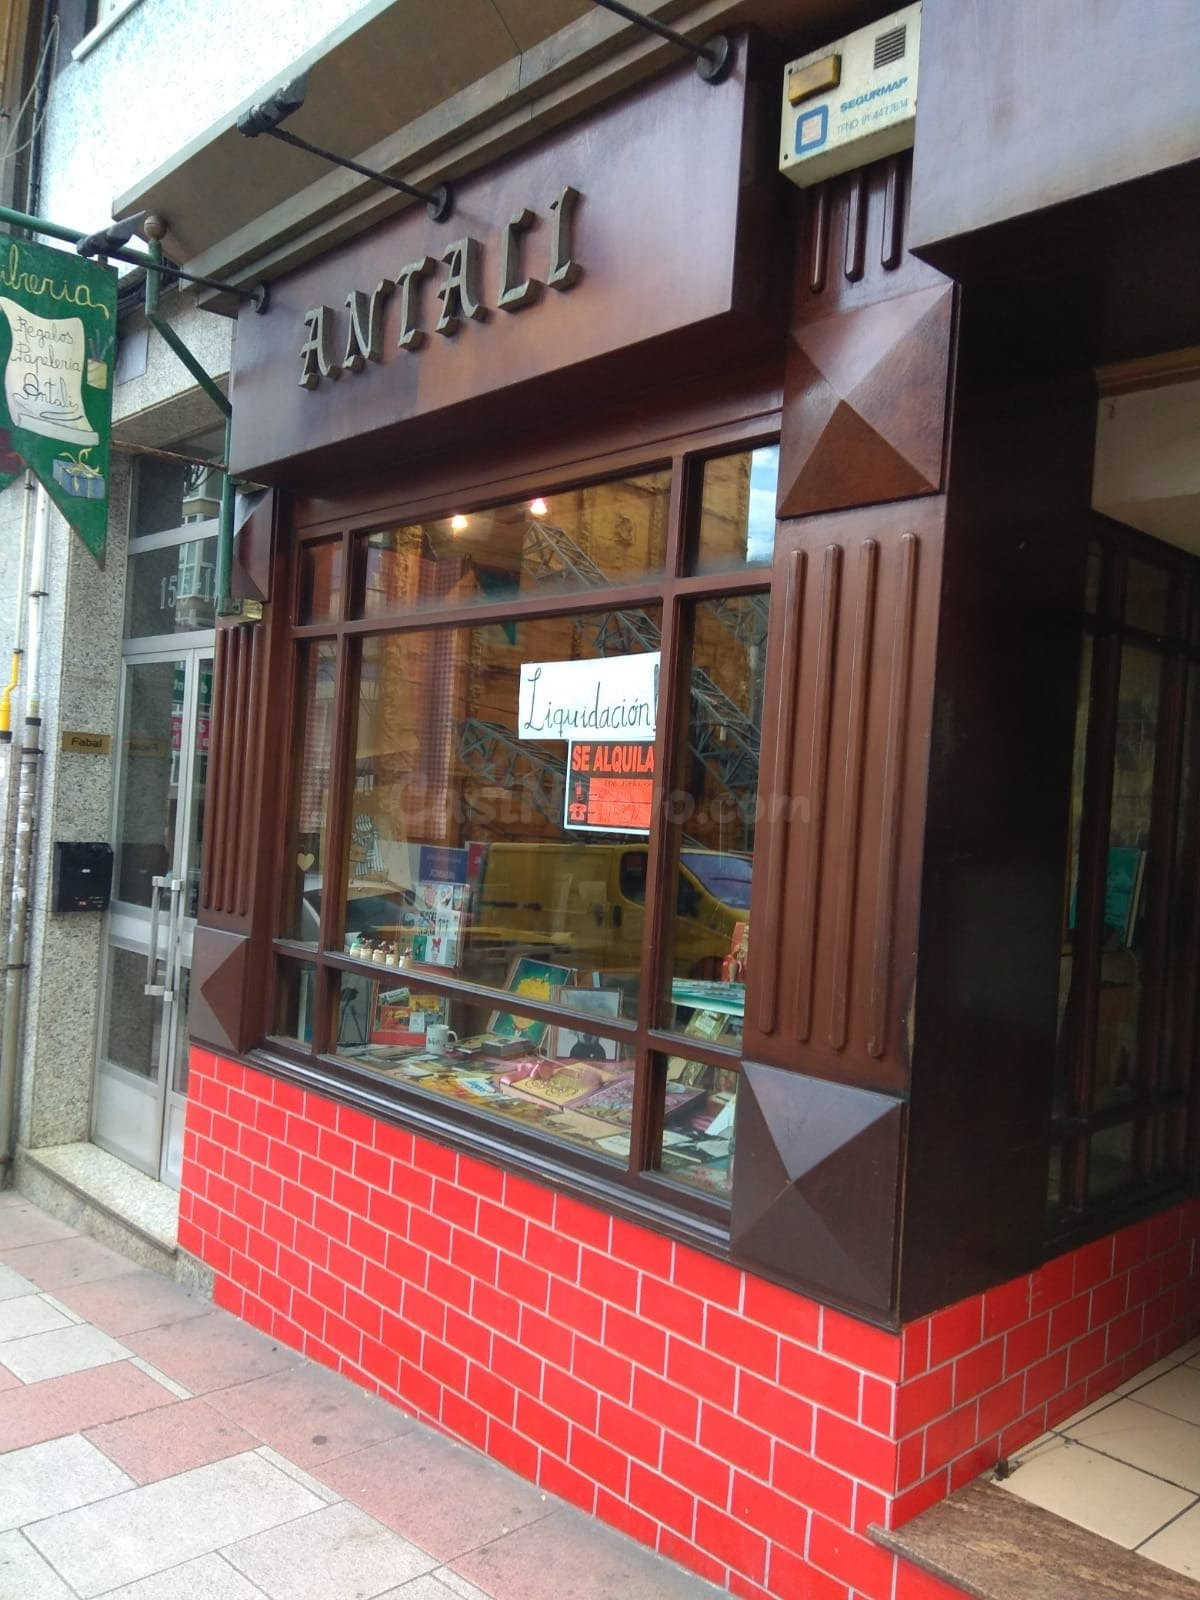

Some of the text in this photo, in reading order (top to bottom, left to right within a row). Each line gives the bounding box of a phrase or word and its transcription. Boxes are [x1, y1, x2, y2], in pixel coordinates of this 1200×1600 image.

[298, 186, 582, 390] ANTALI
[572, 745, 655, 774] SE ALQUILA
